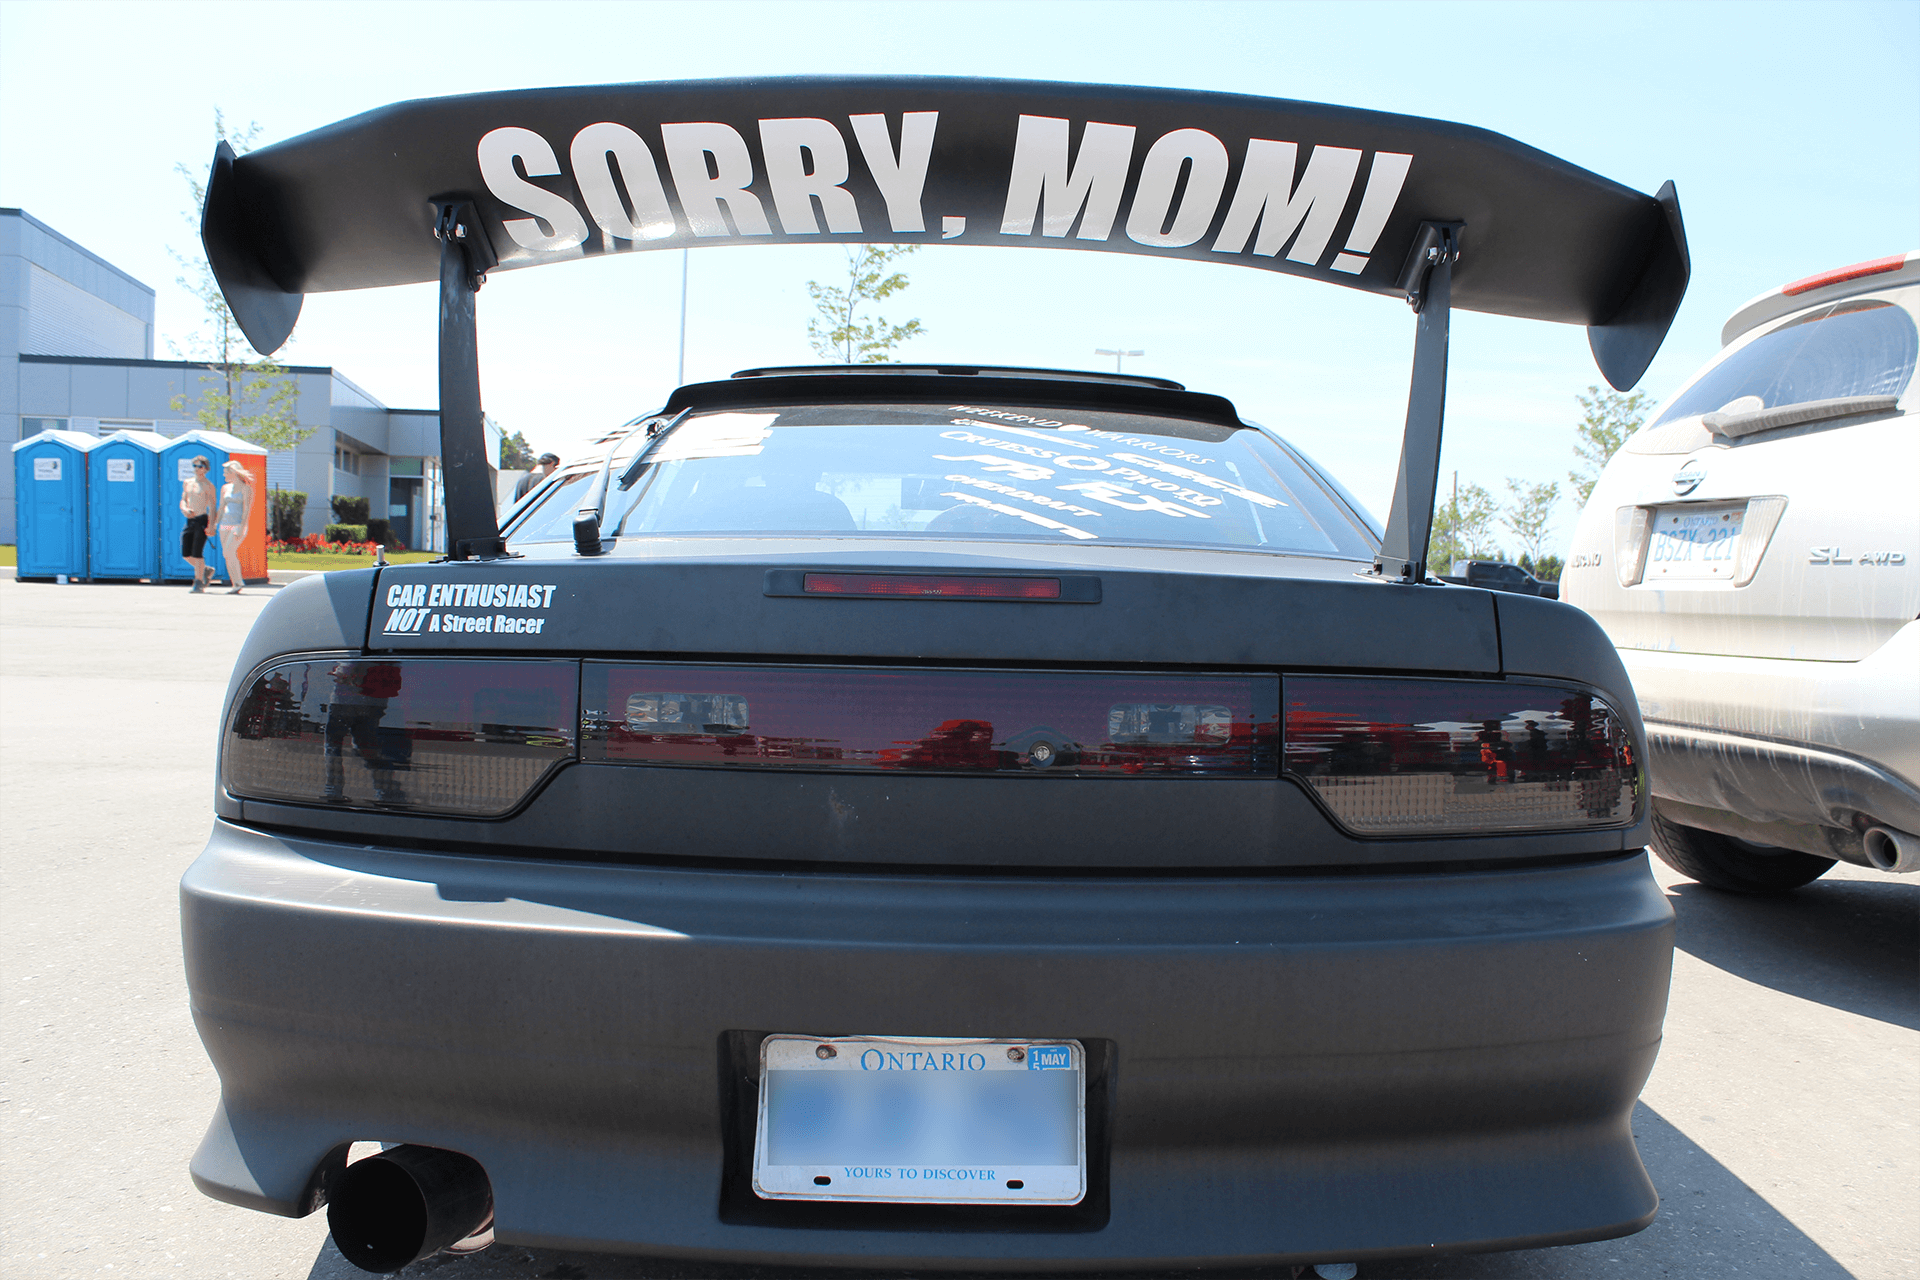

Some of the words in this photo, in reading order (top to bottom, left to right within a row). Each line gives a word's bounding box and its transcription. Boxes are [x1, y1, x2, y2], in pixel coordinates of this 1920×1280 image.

[477, 111, 967, 252] SORRY,
[1000, 114, 1415, 275] MOM!
[1084, 429, 1216, 465] WARRIORS
[939, 430, 1062, 458] CRUESS
[1101, 466, 1222, 505] PHOTO
[944, 474, 1103, 517] OVERDRAFT
[1808, 546, 1853, 566] SL
[1858, 551, 1906, 566] AWD
[386, 584, 427, 608] CAR
[428, 584, 557, 608] ENTHUSIAST
[383, 608, 431, 633] NOT
[428, 614, 441, 633] A
[442, 614, 493, 633] Street
[494, 615, 545, 634] Racer
[860, 1049, 986, 1071] ONTARIO
[1041, 1054, 1066, 1066] MAY
[844, 1167, 892, 1179] YOURS
[897, 1168, 918, 1180] TO
[922, 1168, 996, 1181] DISCOVER
